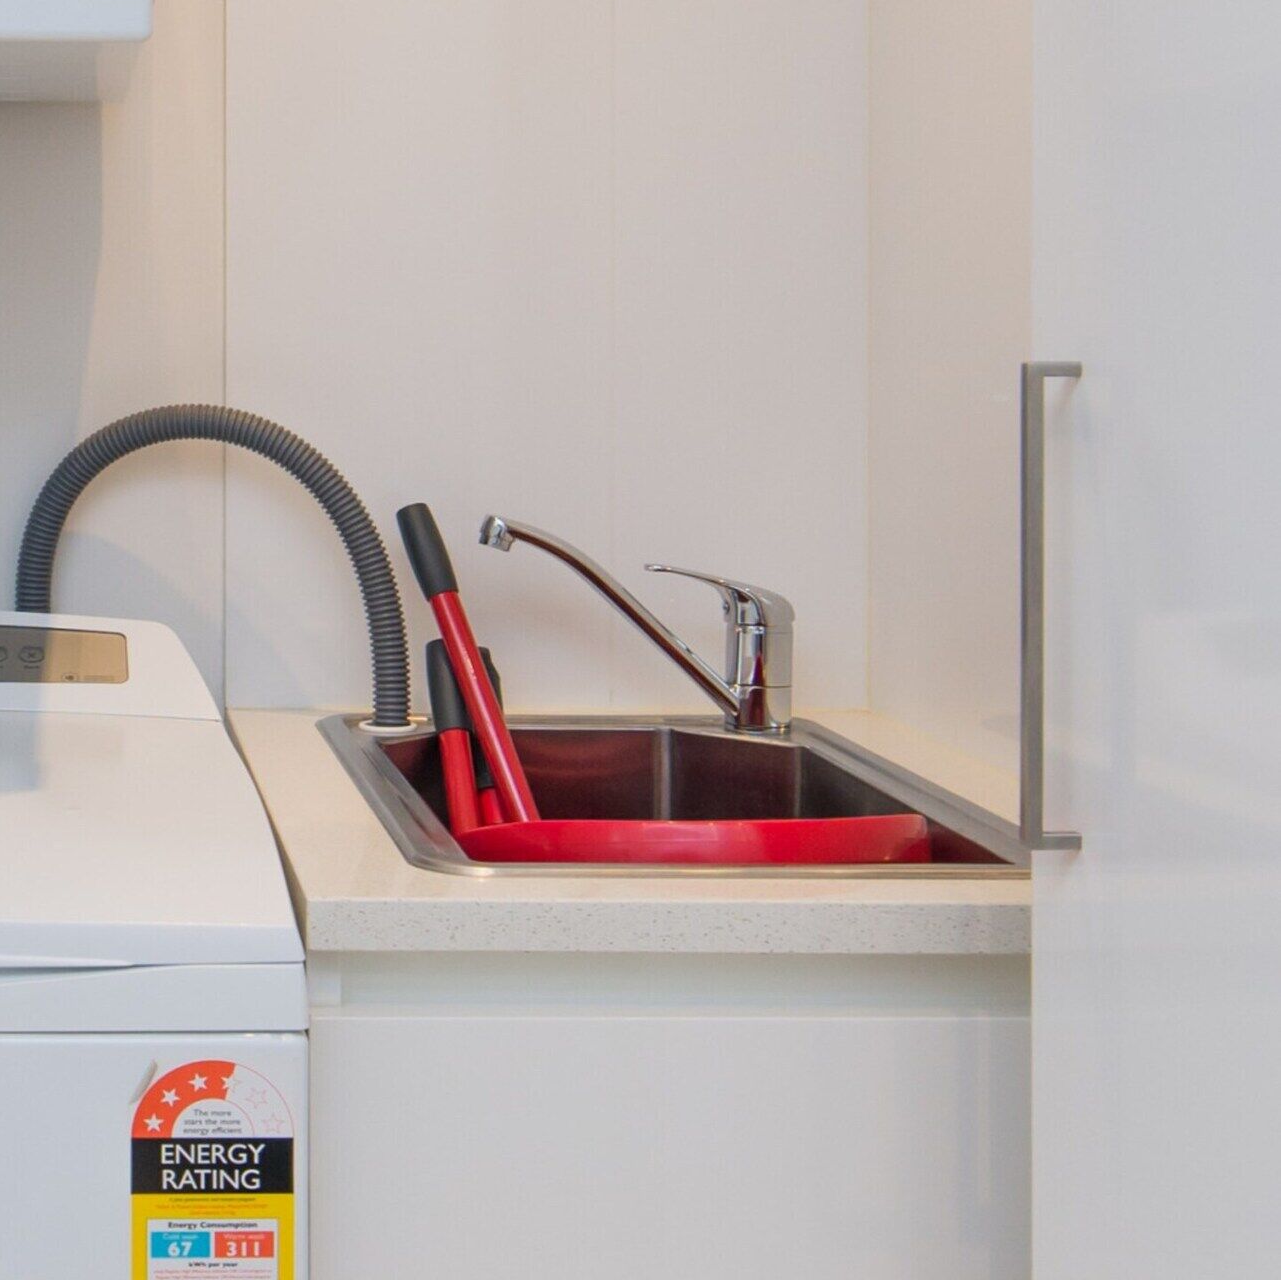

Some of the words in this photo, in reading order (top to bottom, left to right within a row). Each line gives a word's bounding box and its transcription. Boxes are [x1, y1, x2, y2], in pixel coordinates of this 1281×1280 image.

[160, 1143, 266, 1165] ENERGY
[162, 1169, 262, 1190] RATING
[168, 1222, 197, 1230] Energy
[199, 1222, 258, 1230] Consumption
[167, 1241, 193, 1257] 67
[226, 1241, 262, 1257] 311
